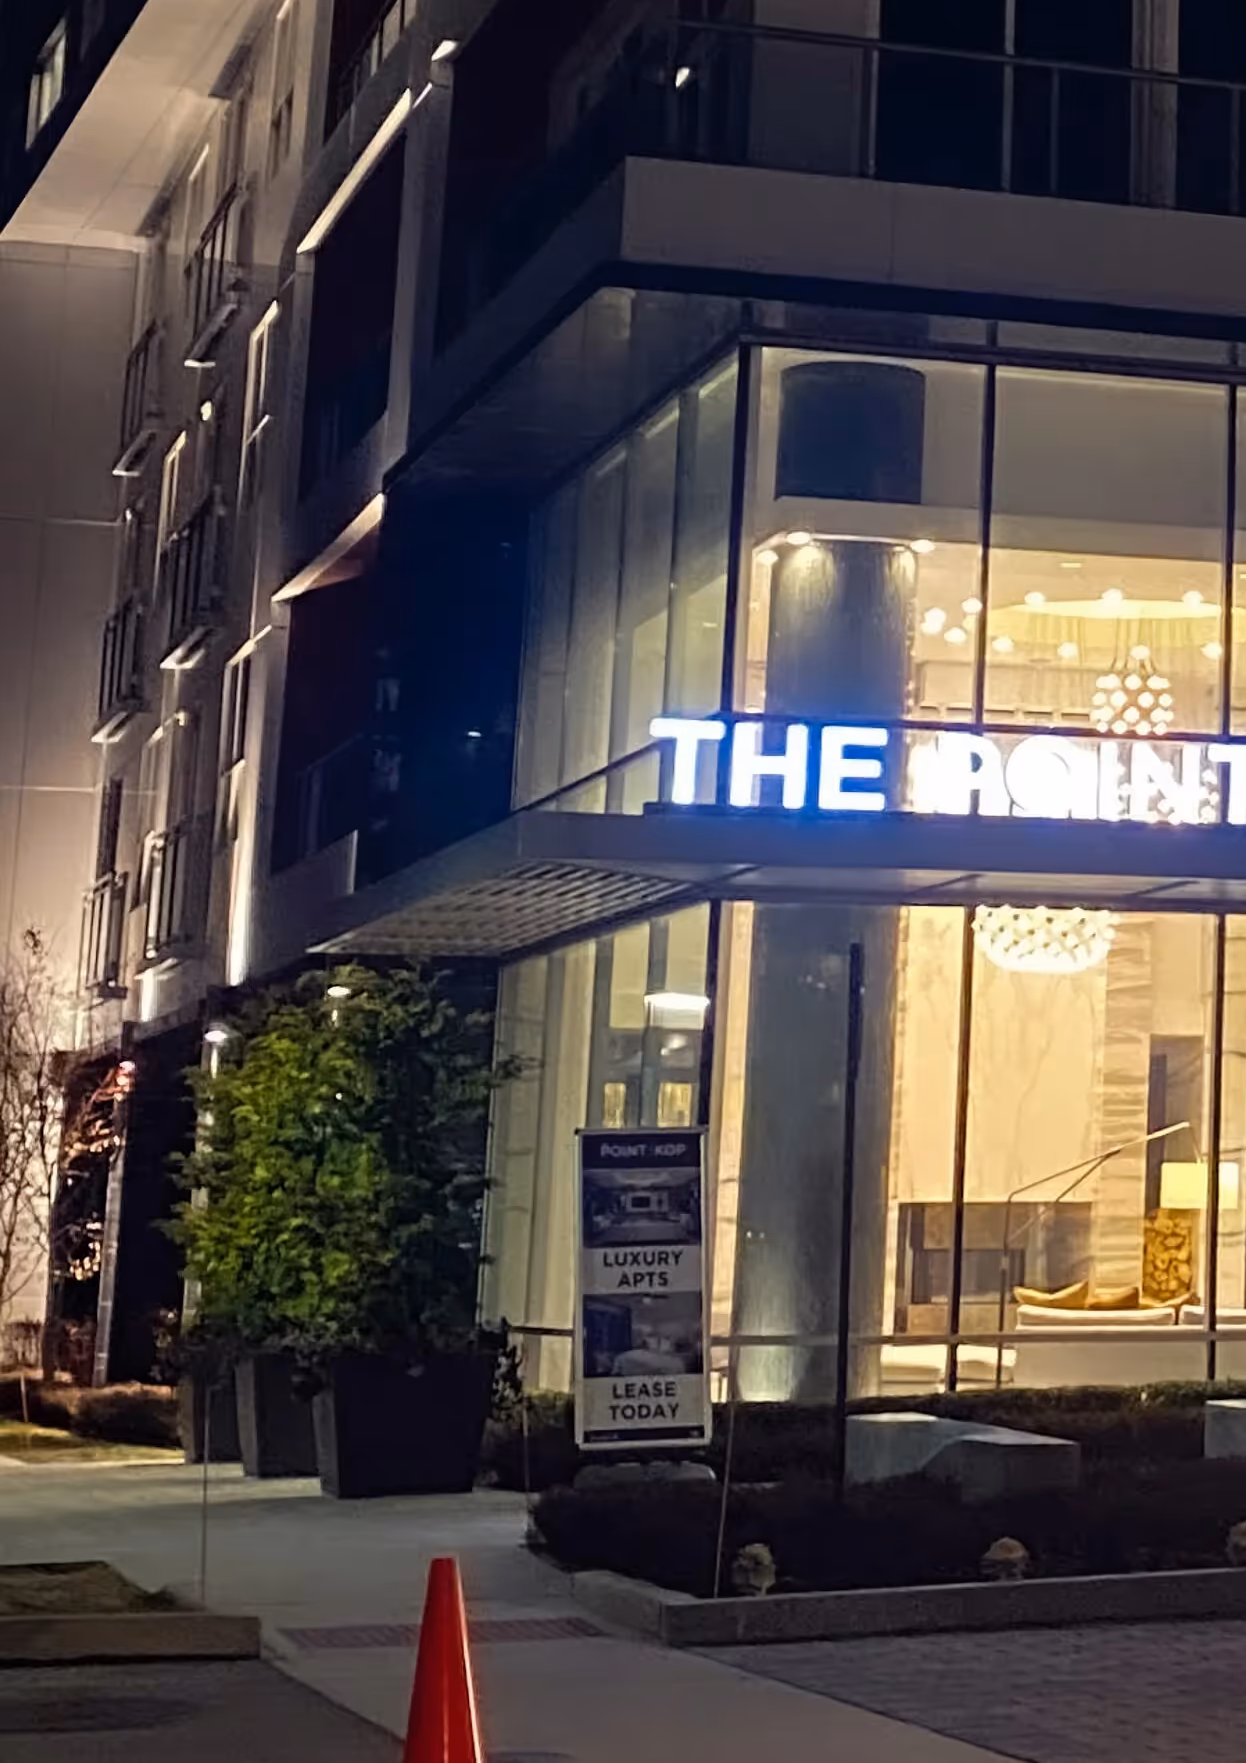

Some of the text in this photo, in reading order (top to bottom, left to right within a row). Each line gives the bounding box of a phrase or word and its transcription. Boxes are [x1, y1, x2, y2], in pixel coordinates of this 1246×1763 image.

[649, 717, 889, 811] THE
[600, 1142, 647, 1158] POINT
[655, 1142, 687, 1158] KOP
[602, 1249, 684, 1268] LUXURY
[617, 1271, 669, 1289] APTS
[612, 1381, 677, 1399] LEASE
[609, 1402, 680, 1422] TODAY
